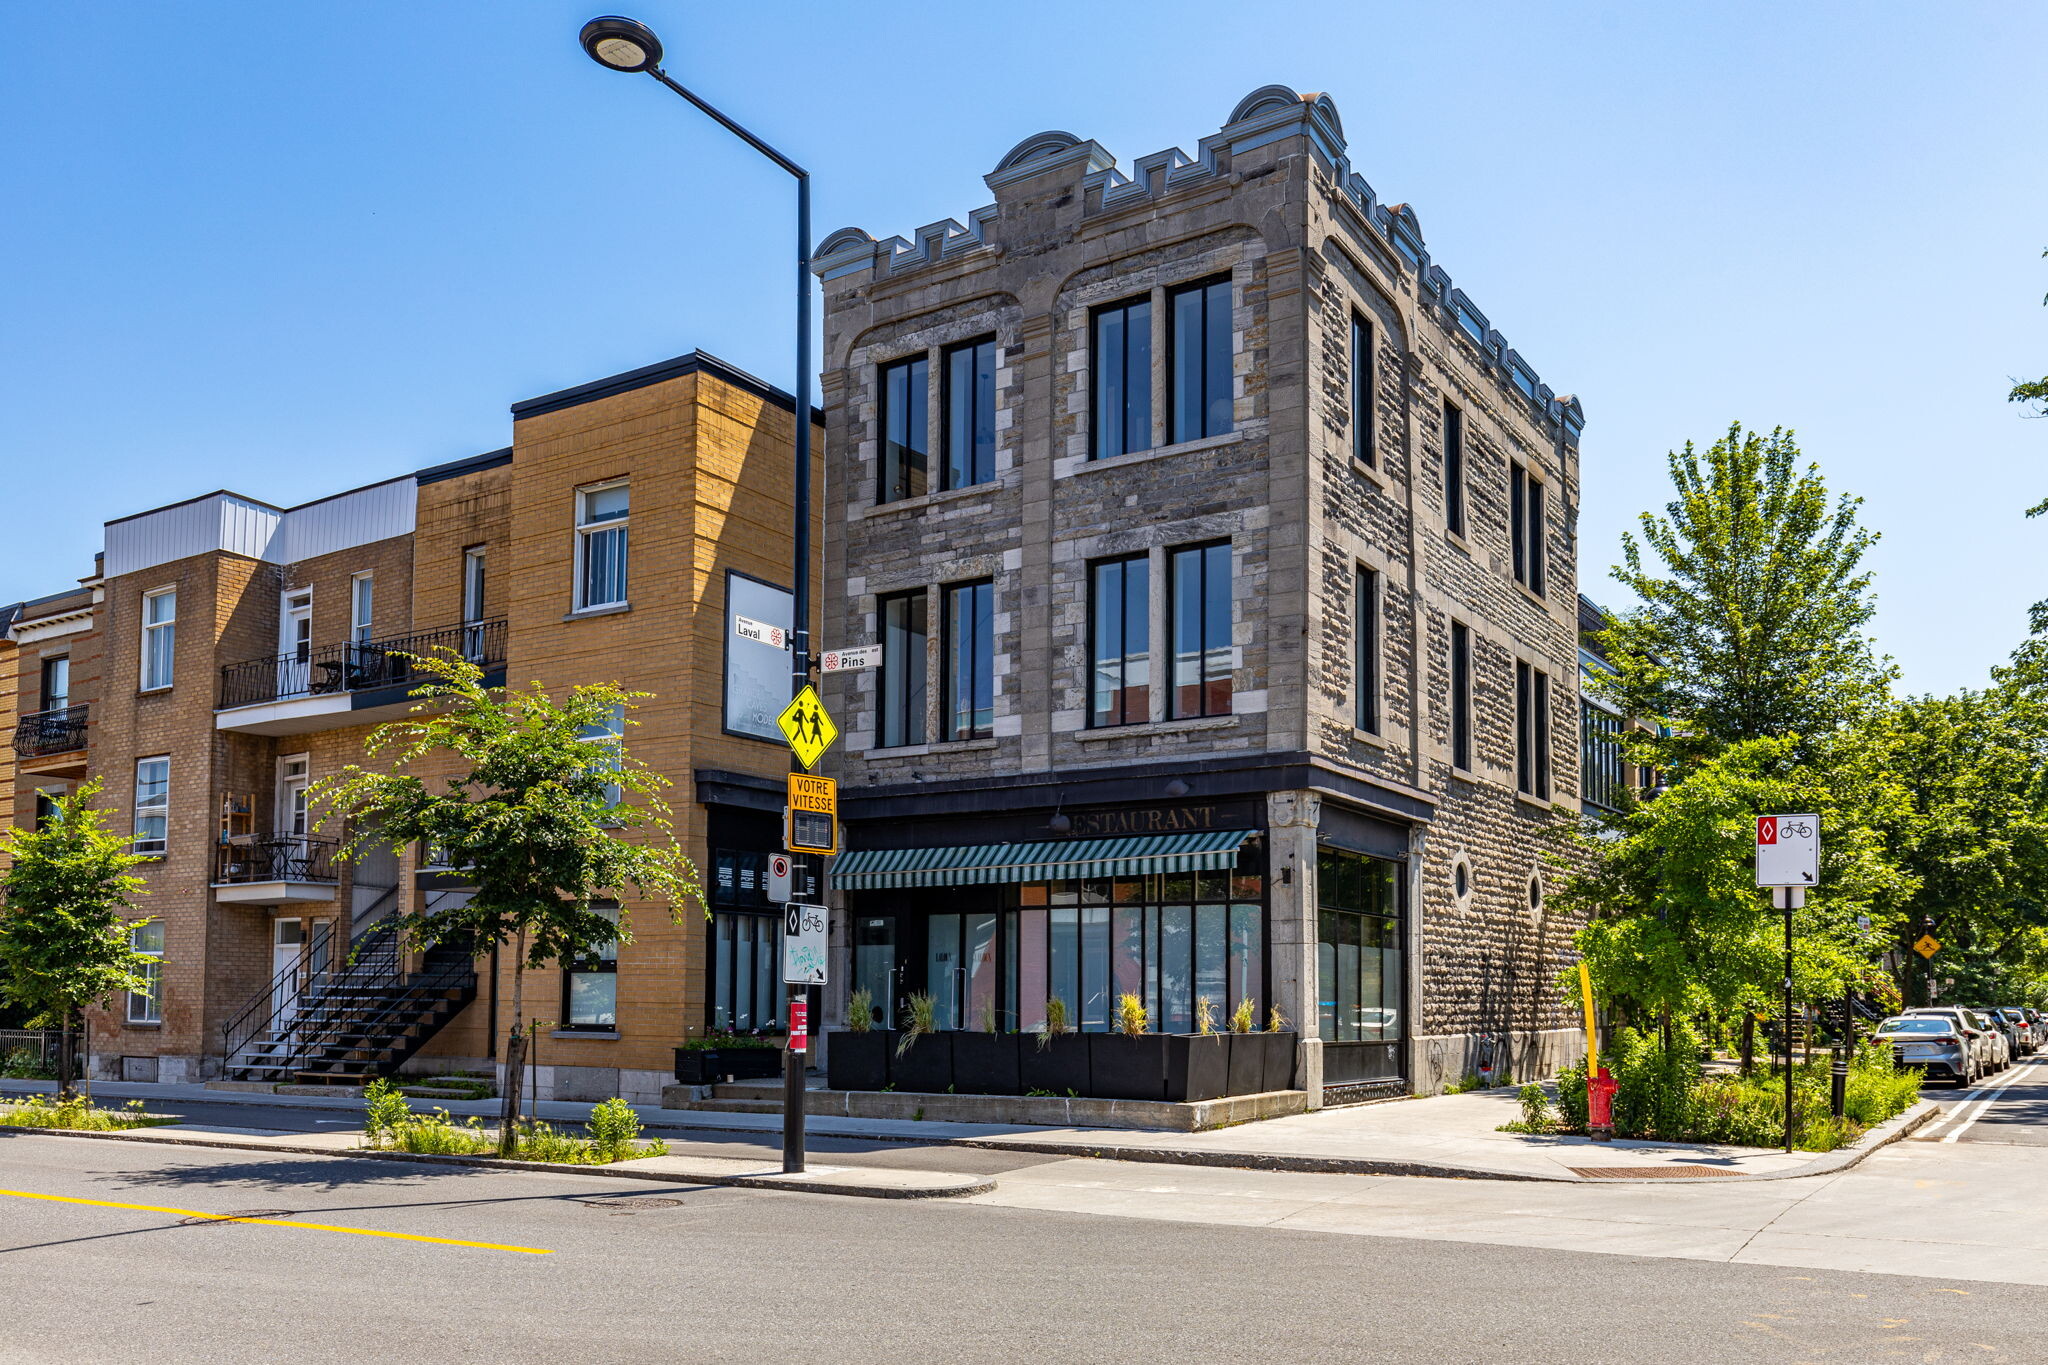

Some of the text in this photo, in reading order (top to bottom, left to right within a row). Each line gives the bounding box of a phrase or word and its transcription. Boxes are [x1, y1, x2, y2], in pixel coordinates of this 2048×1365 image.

[738, 617, 753, 626] Avenue
[738, 623, 760, 640] Laval
[841, 656, 865, 668] Pins
[797, 778, 829, 796] VOTRE
[793, 793, 833, 812] VITESSE
[1071, 806, 1216, 834] ESTAURANT
